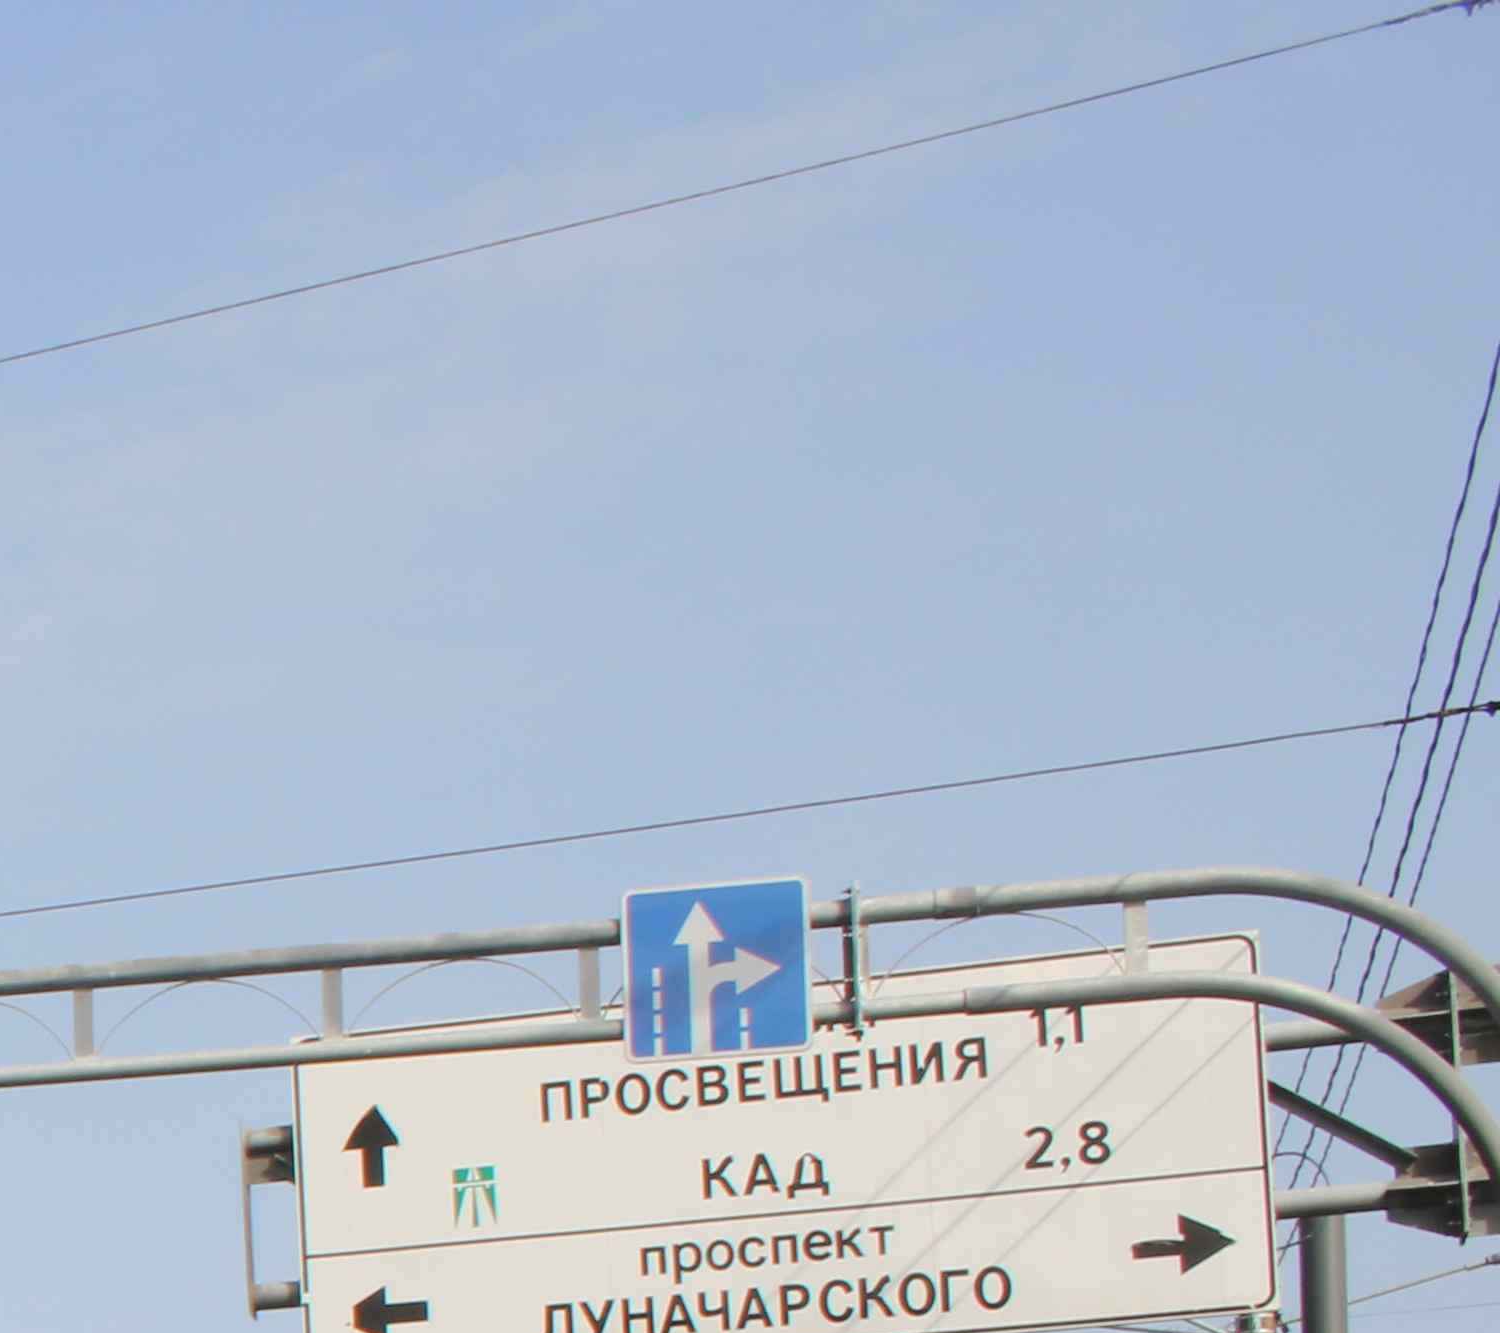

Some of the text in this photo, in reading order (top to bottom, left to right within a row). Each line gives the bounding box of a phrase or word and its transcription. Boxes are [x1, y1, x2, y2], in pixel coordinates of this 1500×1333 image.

[538, 1004, 1085, 1123] ПРОСВЕЩЕНИЯ 1,1
[700, 1120, 1111, 1200] КАД 2,8
[638, 1223, 896, 1284] проспект
